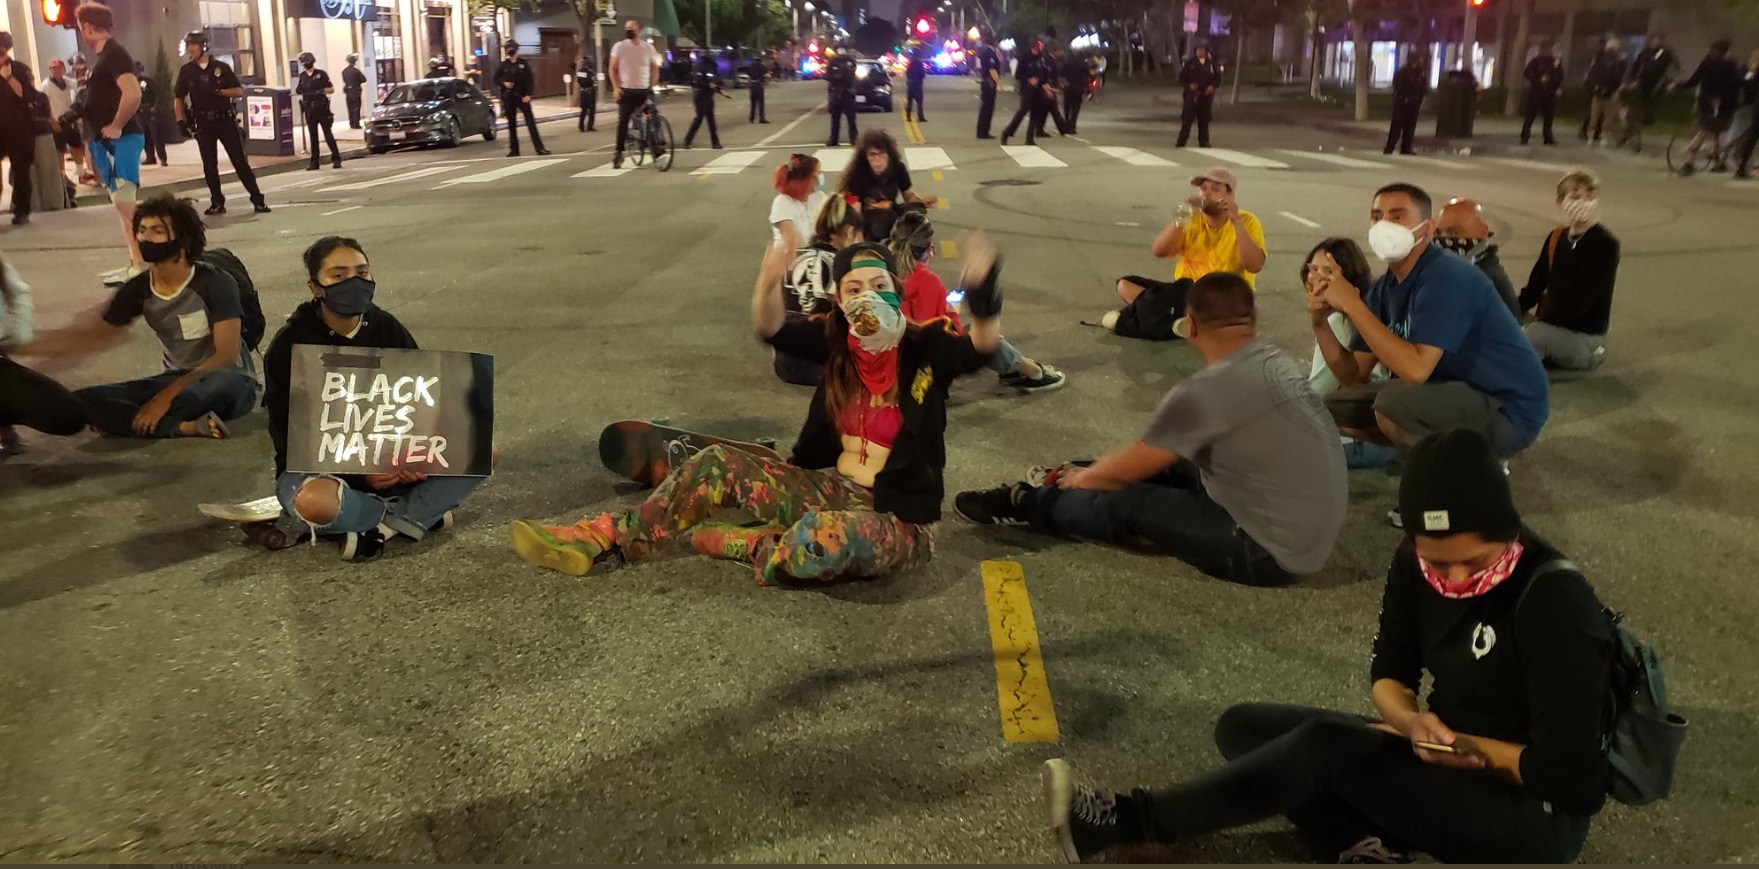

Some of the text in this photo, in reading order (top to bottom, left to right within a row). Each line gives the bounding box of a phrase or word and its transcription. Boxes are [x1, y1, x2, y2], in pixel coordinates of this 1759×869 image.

[321, 371, 439, 407] BLACK
[319, 402, 416, 434] LIVES
[317, 432, 449, 469] MATTER
